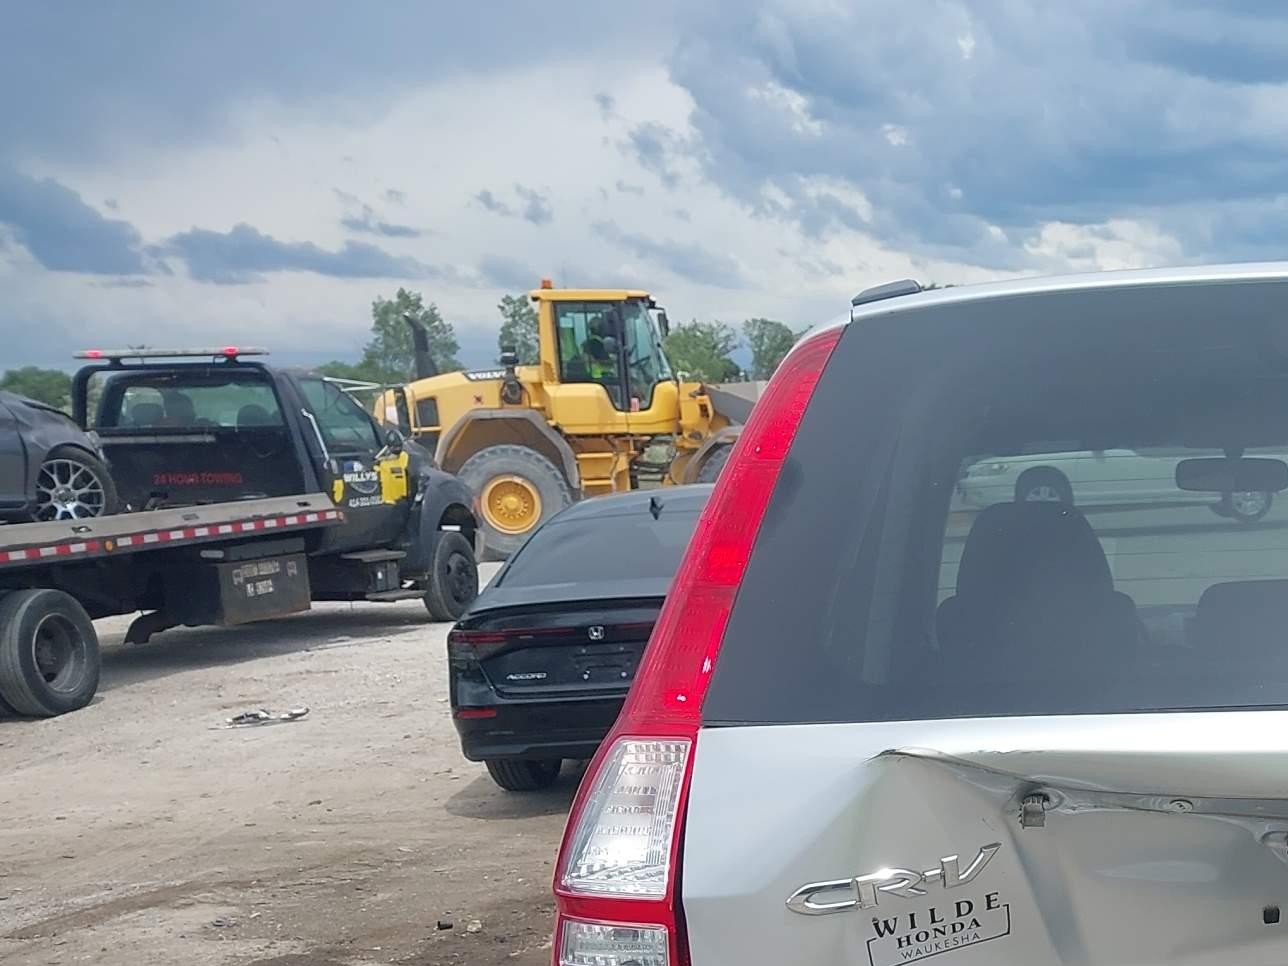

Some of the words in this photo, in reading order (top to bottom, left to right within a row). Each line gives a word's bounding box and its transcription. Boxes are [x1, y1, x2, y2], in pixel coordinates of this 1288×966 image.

[343, 471, 378, 482] WILLYS
[506, 672, 547, 680] ACCORD
[786, 842, 1002, 917] CR-V
[872, 891, 1001, 938] WILDE
[896, 917, 982, 950] HONDA
[900, 932, 981, 961] WAUKESHA
